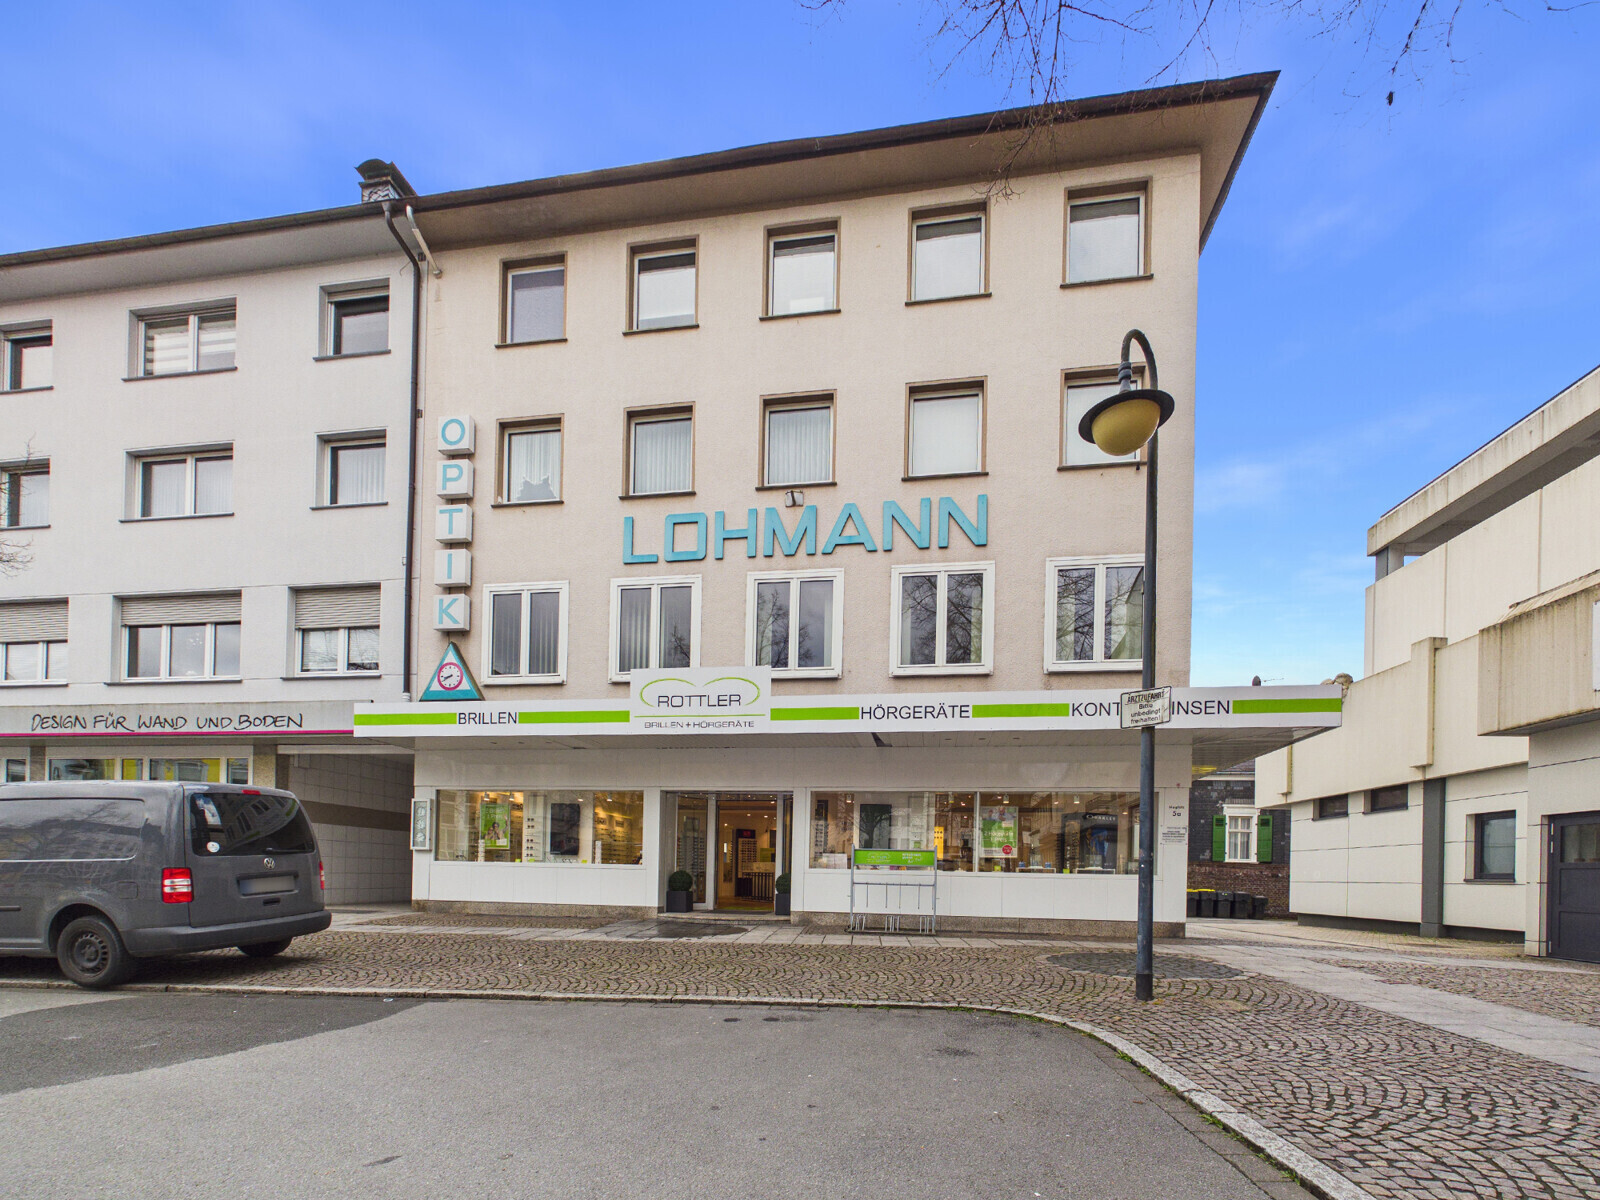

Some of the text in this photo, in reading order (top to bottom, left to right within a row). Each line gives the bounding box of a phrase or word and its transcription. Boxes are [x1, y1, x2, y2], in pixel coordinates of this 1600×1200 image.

[438, 418, 466, 626] OPTIK
[623, 494, 989, 565] LOHMANN
[657, 694, 742, 708] ROTTLER
[458, 711, 518, 725] BRILLEN
[861, 702, 970, 720] HÖRGERÄTE
[1130, 708, 1161, 718] unbedingt
[31, 711, 303, 732] DESIGN FÜR WAND UND BODEN
[644, 721, 684, 729] BRILLEN
[692, 720, 755, 729] HÖRGERÄTE
[1130, 715, 1161, 725] freihalten!
